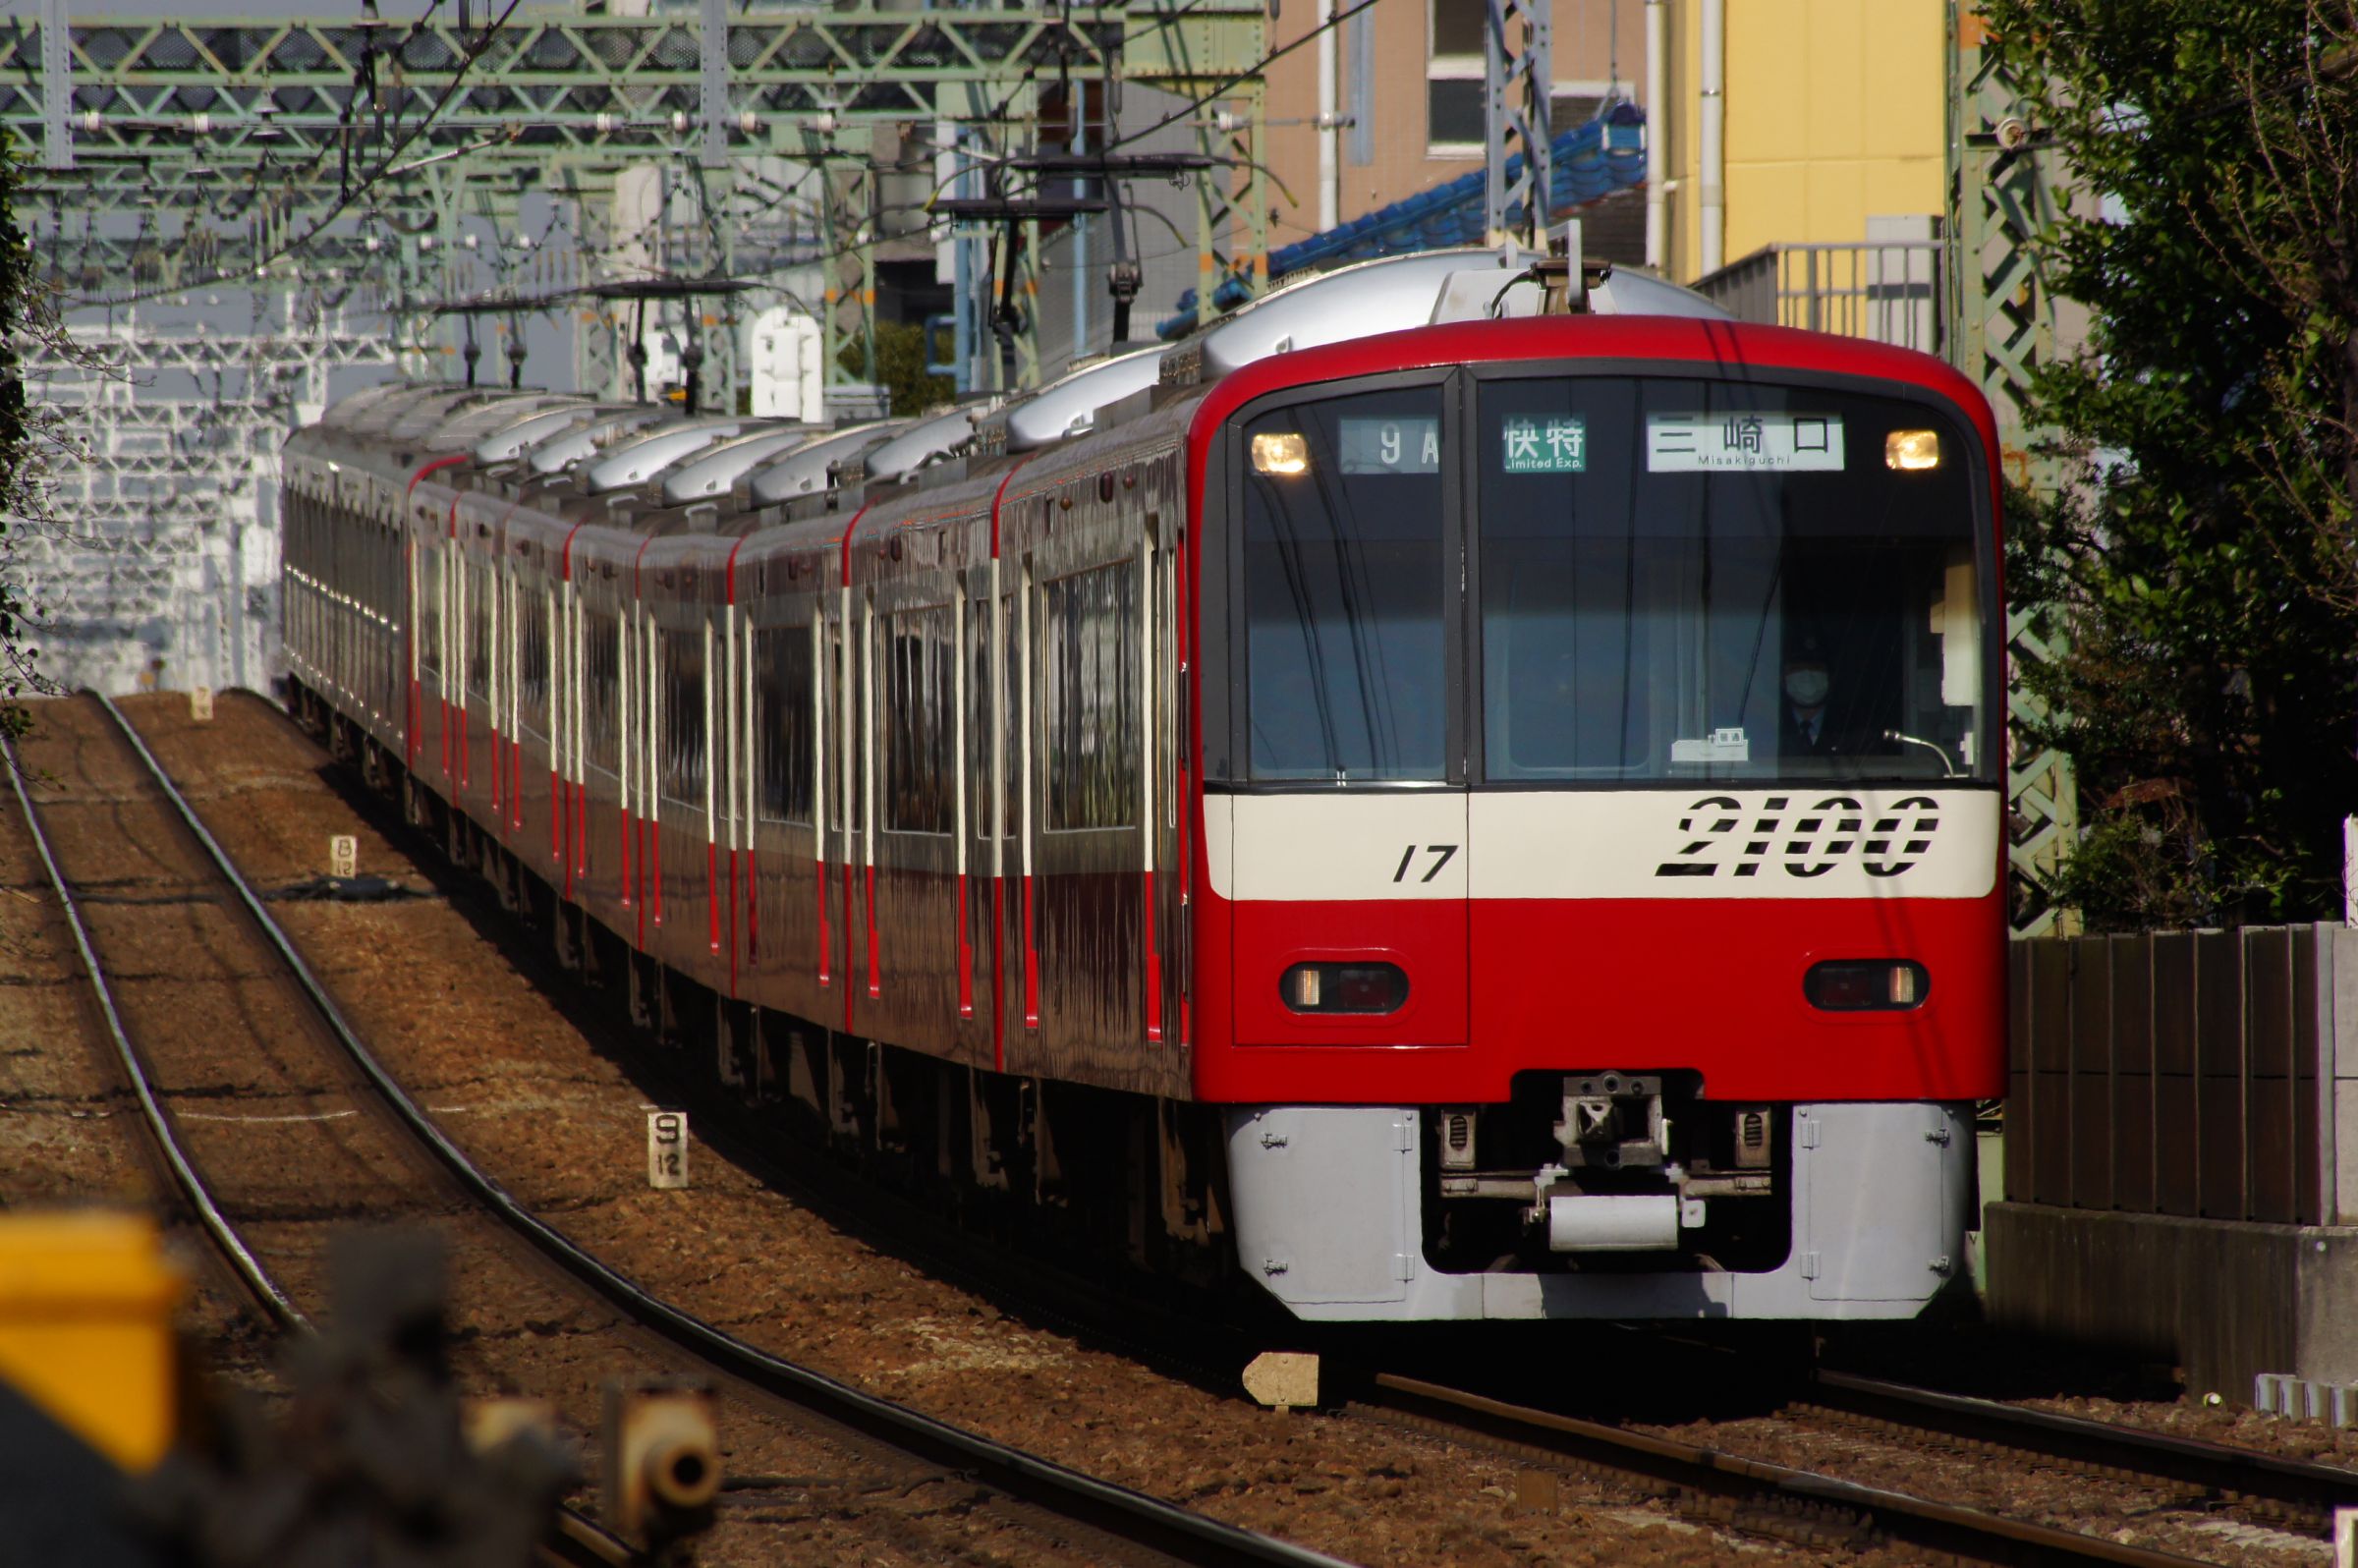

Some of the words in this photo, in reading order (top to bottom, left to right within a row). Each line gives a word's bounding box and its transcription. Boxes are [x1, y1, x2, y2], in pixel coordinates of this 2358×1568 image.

[1380, 421, 1400, 465] 9
[1421, 423, 1439, 465] A
[1502, 418, 1584, 459] 快特
[1656, 414, 1828, 454] 三崎口
[1556, 458, 1583, 470] Exp.
[1698, 455, 1790, 467] Misakiguchi
[1655, 796, 1939, 877] 2100
[1393, 845, 1459, 883] 17
[655, 1114, 680, 1144] 9
[657, 1153, 681, 1177] 12
